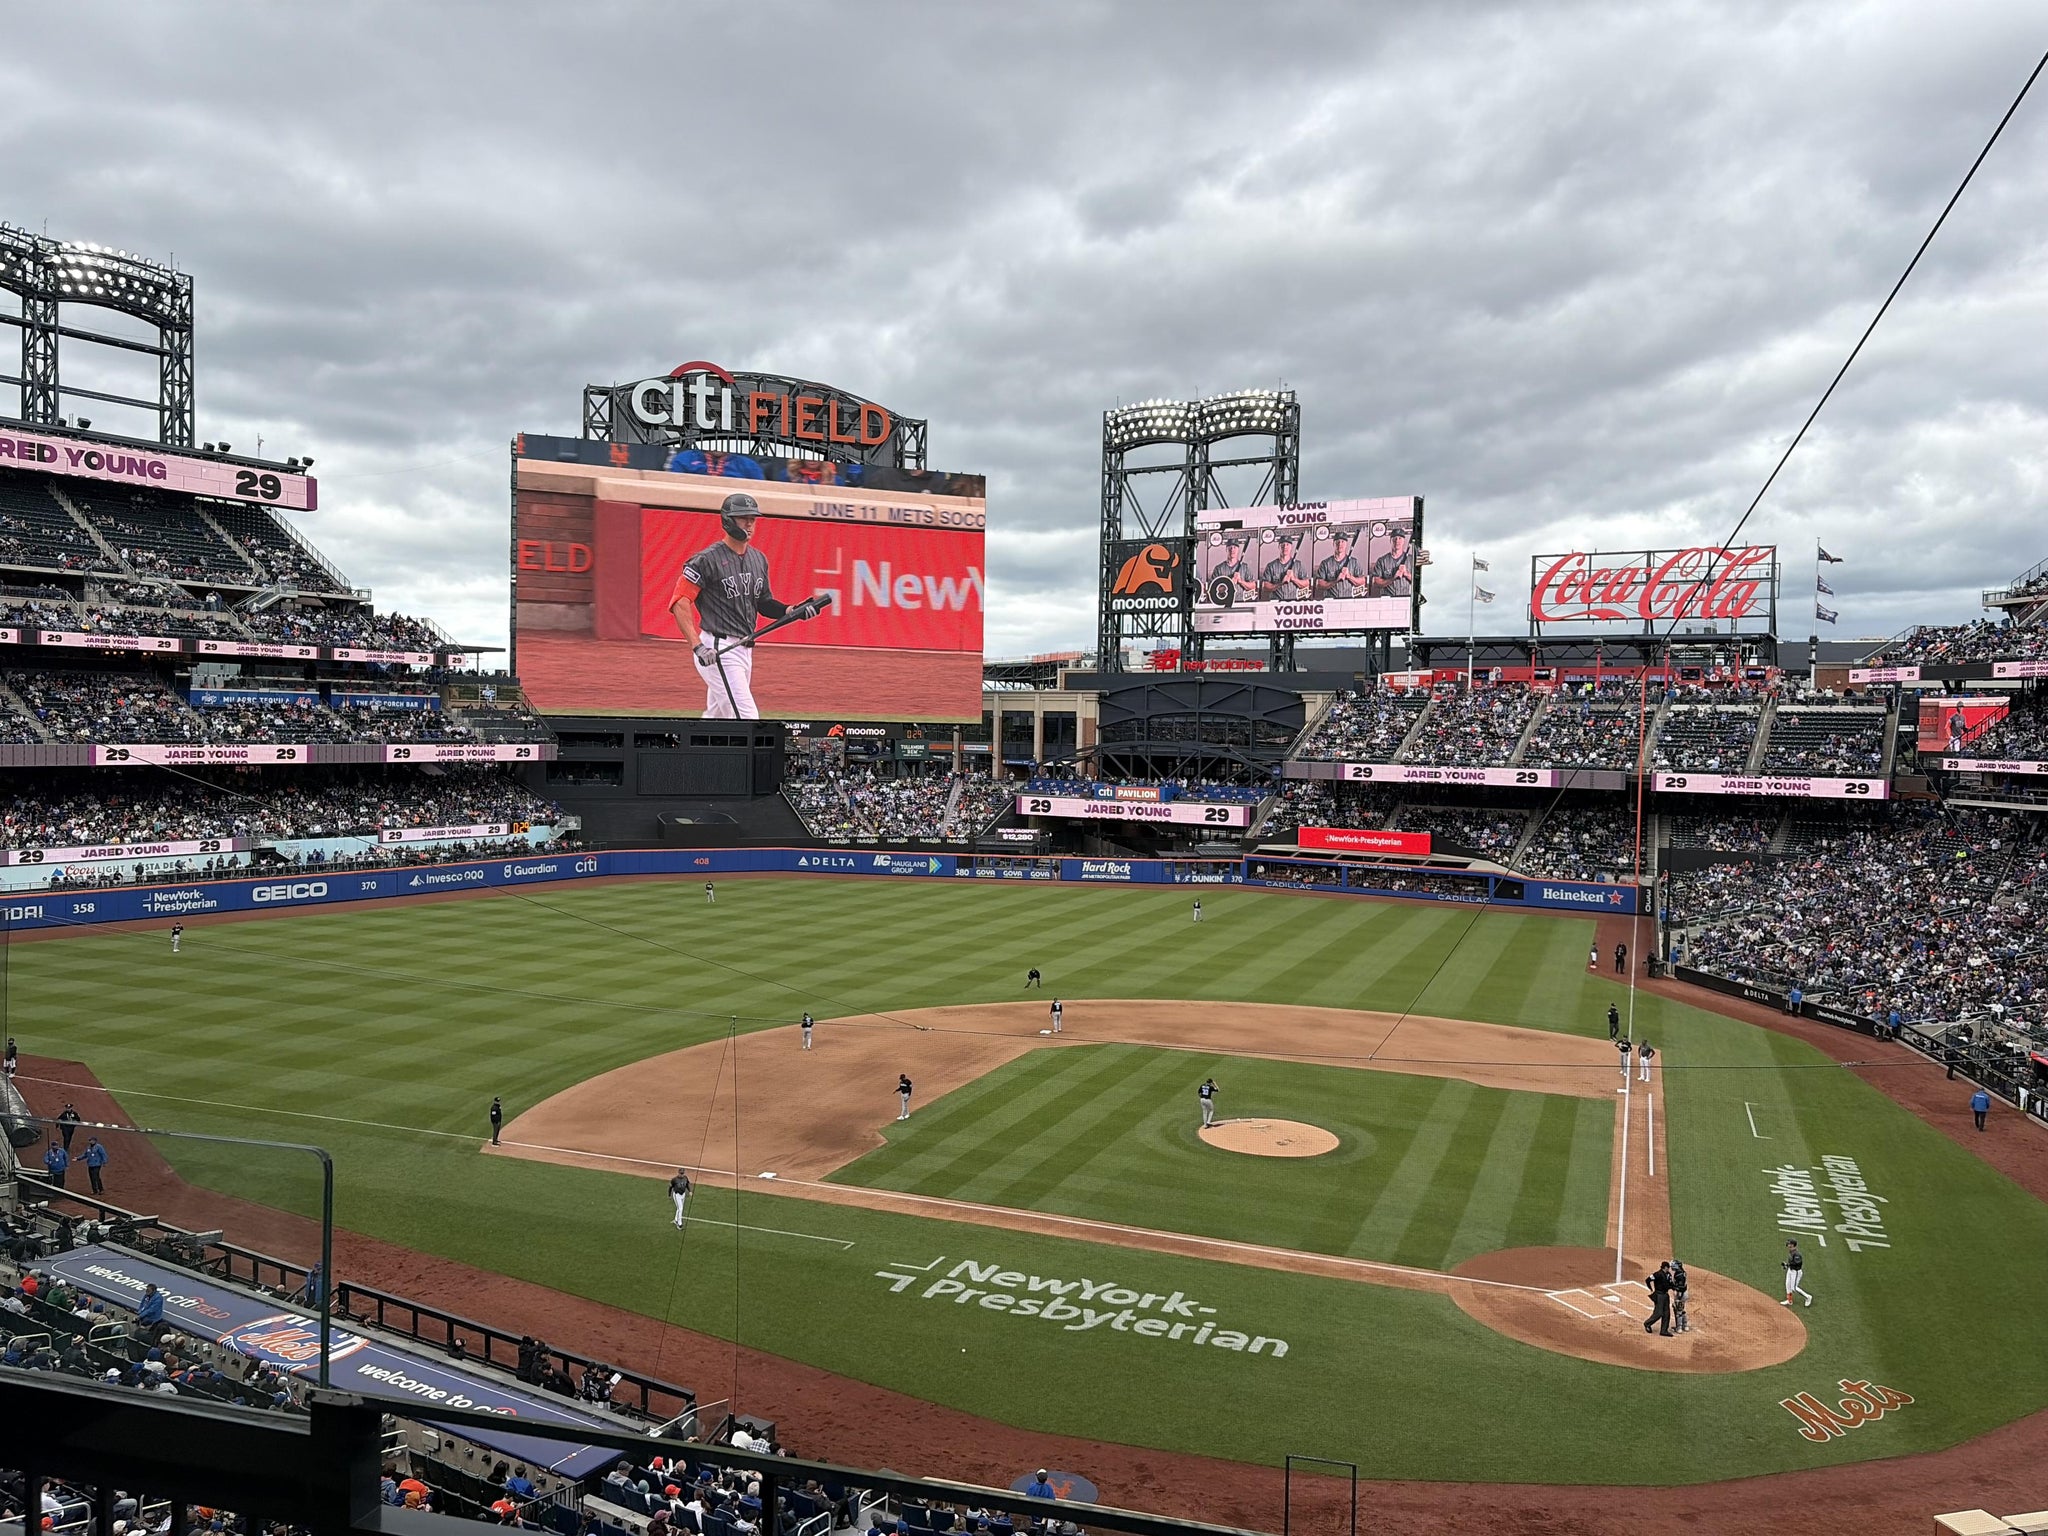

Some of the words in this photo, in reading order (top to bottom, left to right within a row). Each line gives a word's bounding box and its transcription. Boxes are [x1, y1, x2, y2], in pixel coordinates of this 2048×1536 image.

[632, 368, 734, 430] citi
[749, 391, 890, 445] FIELD
[63, 448, 167, 480] YOUNG
[236, 470, 282, 500] 29
[809, 502, 855, 518] JUNE
[861, 506, 877, 520] 11
[888, 507, 934, 524] METS
[939, 510, 985, 527] SOCC
[1277, 512, 1327, 524] YOUNG
[518, 541, 593, 573] ELD
[721, 572, 764, 599] NYC
[1531, 545, 1776, 621] Coca-Cola
[1112, 597, 1178, 610] moomoo
[1274, 604, 1324, 615] YOUNG
[1273, 617, 1323, 629] YOUNG
[47, 634, 62, 642] 29
[112, 638, 139, 646] YOUNG
[157, 640, 171, 648] 29
[1183, 660, 1206, 670] new
[1211, 658, 1264, 670] balance
[846, 727, 885, 735] moomoo
[105, 748, 129, 761] 29
[164, 750, 206, 759] JARED
[208, 750, 249, 759] YOUNG
[276, 748, 296, 760] 29
[394, 748, 410, 759] 29
[435, 749, 464, 757] JARED
[516, 748, 531, 757] 29
[1948, 760, 1959, 768] 29
[2037, 763, 2048, 772] 29
[1353, 767, 1372, 778] 29
[1404, 770, 1441, 779] JARED
[1445, 771, 1485, 780] YOUNG
[1516, 772, 1538, 783] 29
[1665, 777, 1687, 788] 29
[1721, 780, 1762, 788] JARED
[1766, 781, 1811, 791] YOUNG
[1844, 782, 1869, 794] 29
[1099, 787, 1113, 797] citi
[1118, 790, 1157, 799] PAVILION
[1030, 799, 1052, 812] 29
[1084, 804, 1125, 815] JARED
[1128, 806, 1172, 817] YOUNG
[1205, 808, 1229, 822] 29
[423, 829, 446, 837] JARED
[488, 825, 501, 834] 29
[513, 822, 530, 834] 0:29
[389, 831, 402, 840] 29
[1329, 834, 1402, 847] NewYork-Presbyterian
[82, 846, 124, 858] JARED
[127, 845, 169, 855] YOUNG
[200, 840, 221, 852] 29
[19, 850, 44, 863] 29
[812, 857, 855, 867] DELTA
[65, 864, 96, 876] Coors
[98, 864, 125, 875] LIGHT
[132, 863, 161, 871] FSTA
[514, 864, 558, 876] Guardian
[576, 857, 597, 873] citi
[1082, 861, 1107, 872] Hard
[1107, 862, 1131, 875] Rock
[955, 868, 969, 876] 380
[426, 873, 462, 884] Invesco
[1192, 875, 1224, 883] DUNKIN'
[1231, 875, 1243, 883] 370
[361, 881, 377, 890] 370
[1266, 881, 1312, 890] CADILLAC
[154, 890, 203, 902] NewYork-
[253, 882, 328, 902] GEICO
[1543, 888, 1605, 903] Heineken
[1437, 894, 1490, 904] CADILLAC
[72, 903, 95, 913] 358
[154, 899, 217, 913] Presbyterian
[1750, 989, 1769, 1001] DELTA
[1762, 1164, 1828, 1230] NewYork-
[1811, 1155, 1889, 1238] Presbyterian
[84, 1264, 147, 1291] welcome
[167, 1295, 201, 1308] citi
[198, 1303, 231, 1320] FIELD
[948, 1259, 1217, 1317] NewYork-
[921, 1278, 1289, 1357] Presbyterian
[238, 1328, 322, 1361] Mets
[357, 1363, 448, 1401] welcome
[446, 1392, 473, 1408] to
[1778, 1378, 1915, 1442] Mets
